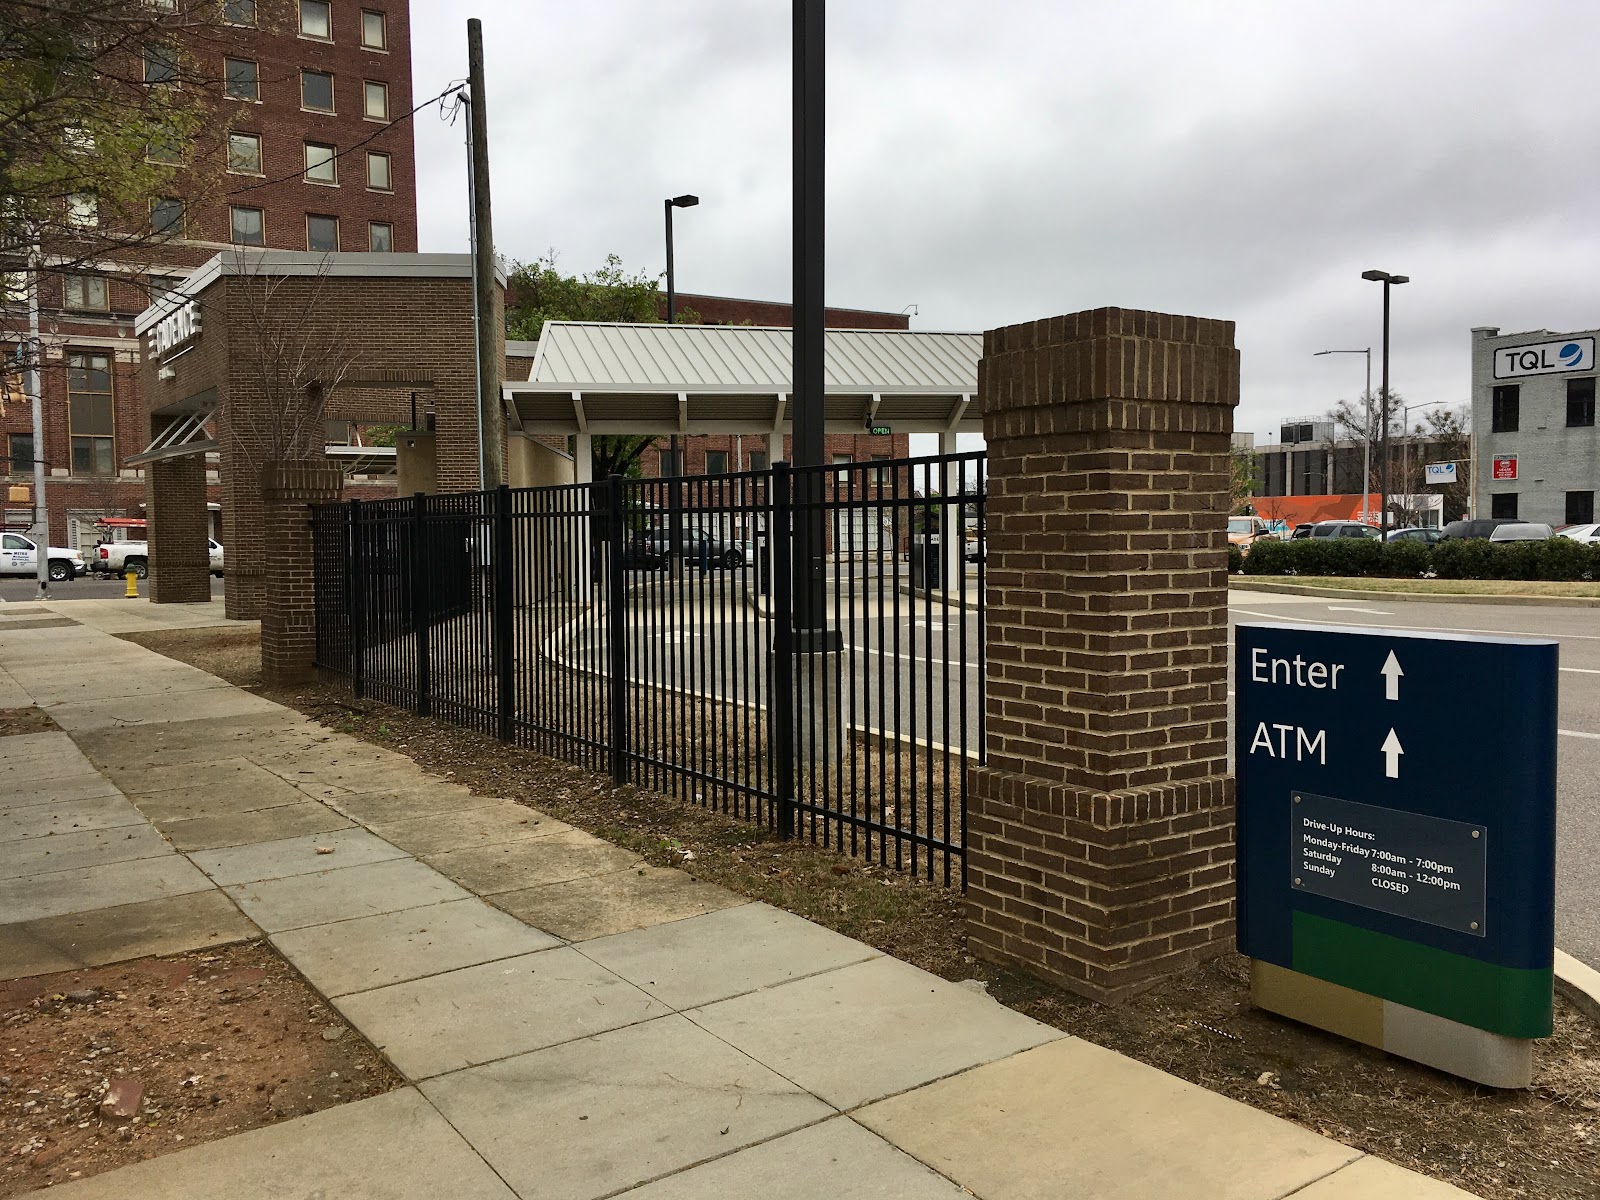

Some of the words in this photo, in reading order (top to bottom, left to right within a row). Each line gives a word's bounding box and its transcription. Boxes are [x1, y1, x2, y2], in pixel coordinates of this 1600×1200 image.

[156, 300, 202, 354] CADENCE
[1505, 349, 1555, 372] TQL
[872, 427, 890, 435] OPEN
[1426, 465, 1445, 474] TQL
[1252, 647, 1345, 690] Enter
[1249, 721, 1326, 765] ATM
[1303, 817, 1343, 835] Drive-Up
[1344, 827, 1376, 841] Hours:
[1303, 834, 1370, 858] Monday-Friday
[1371, 849, 1406, 864] 7:00am
[1415, 857, 1454, 874] 7:00pm
[1303, 847, 1342, 866] Saturday
[1371, 863, 1407, 879] 8:00am
[1416, 873, 1461, 891] 12:00pm
[1303, 861, 1336, 878] Sunday
[1371, 877, 1409, 894] CLOSED
